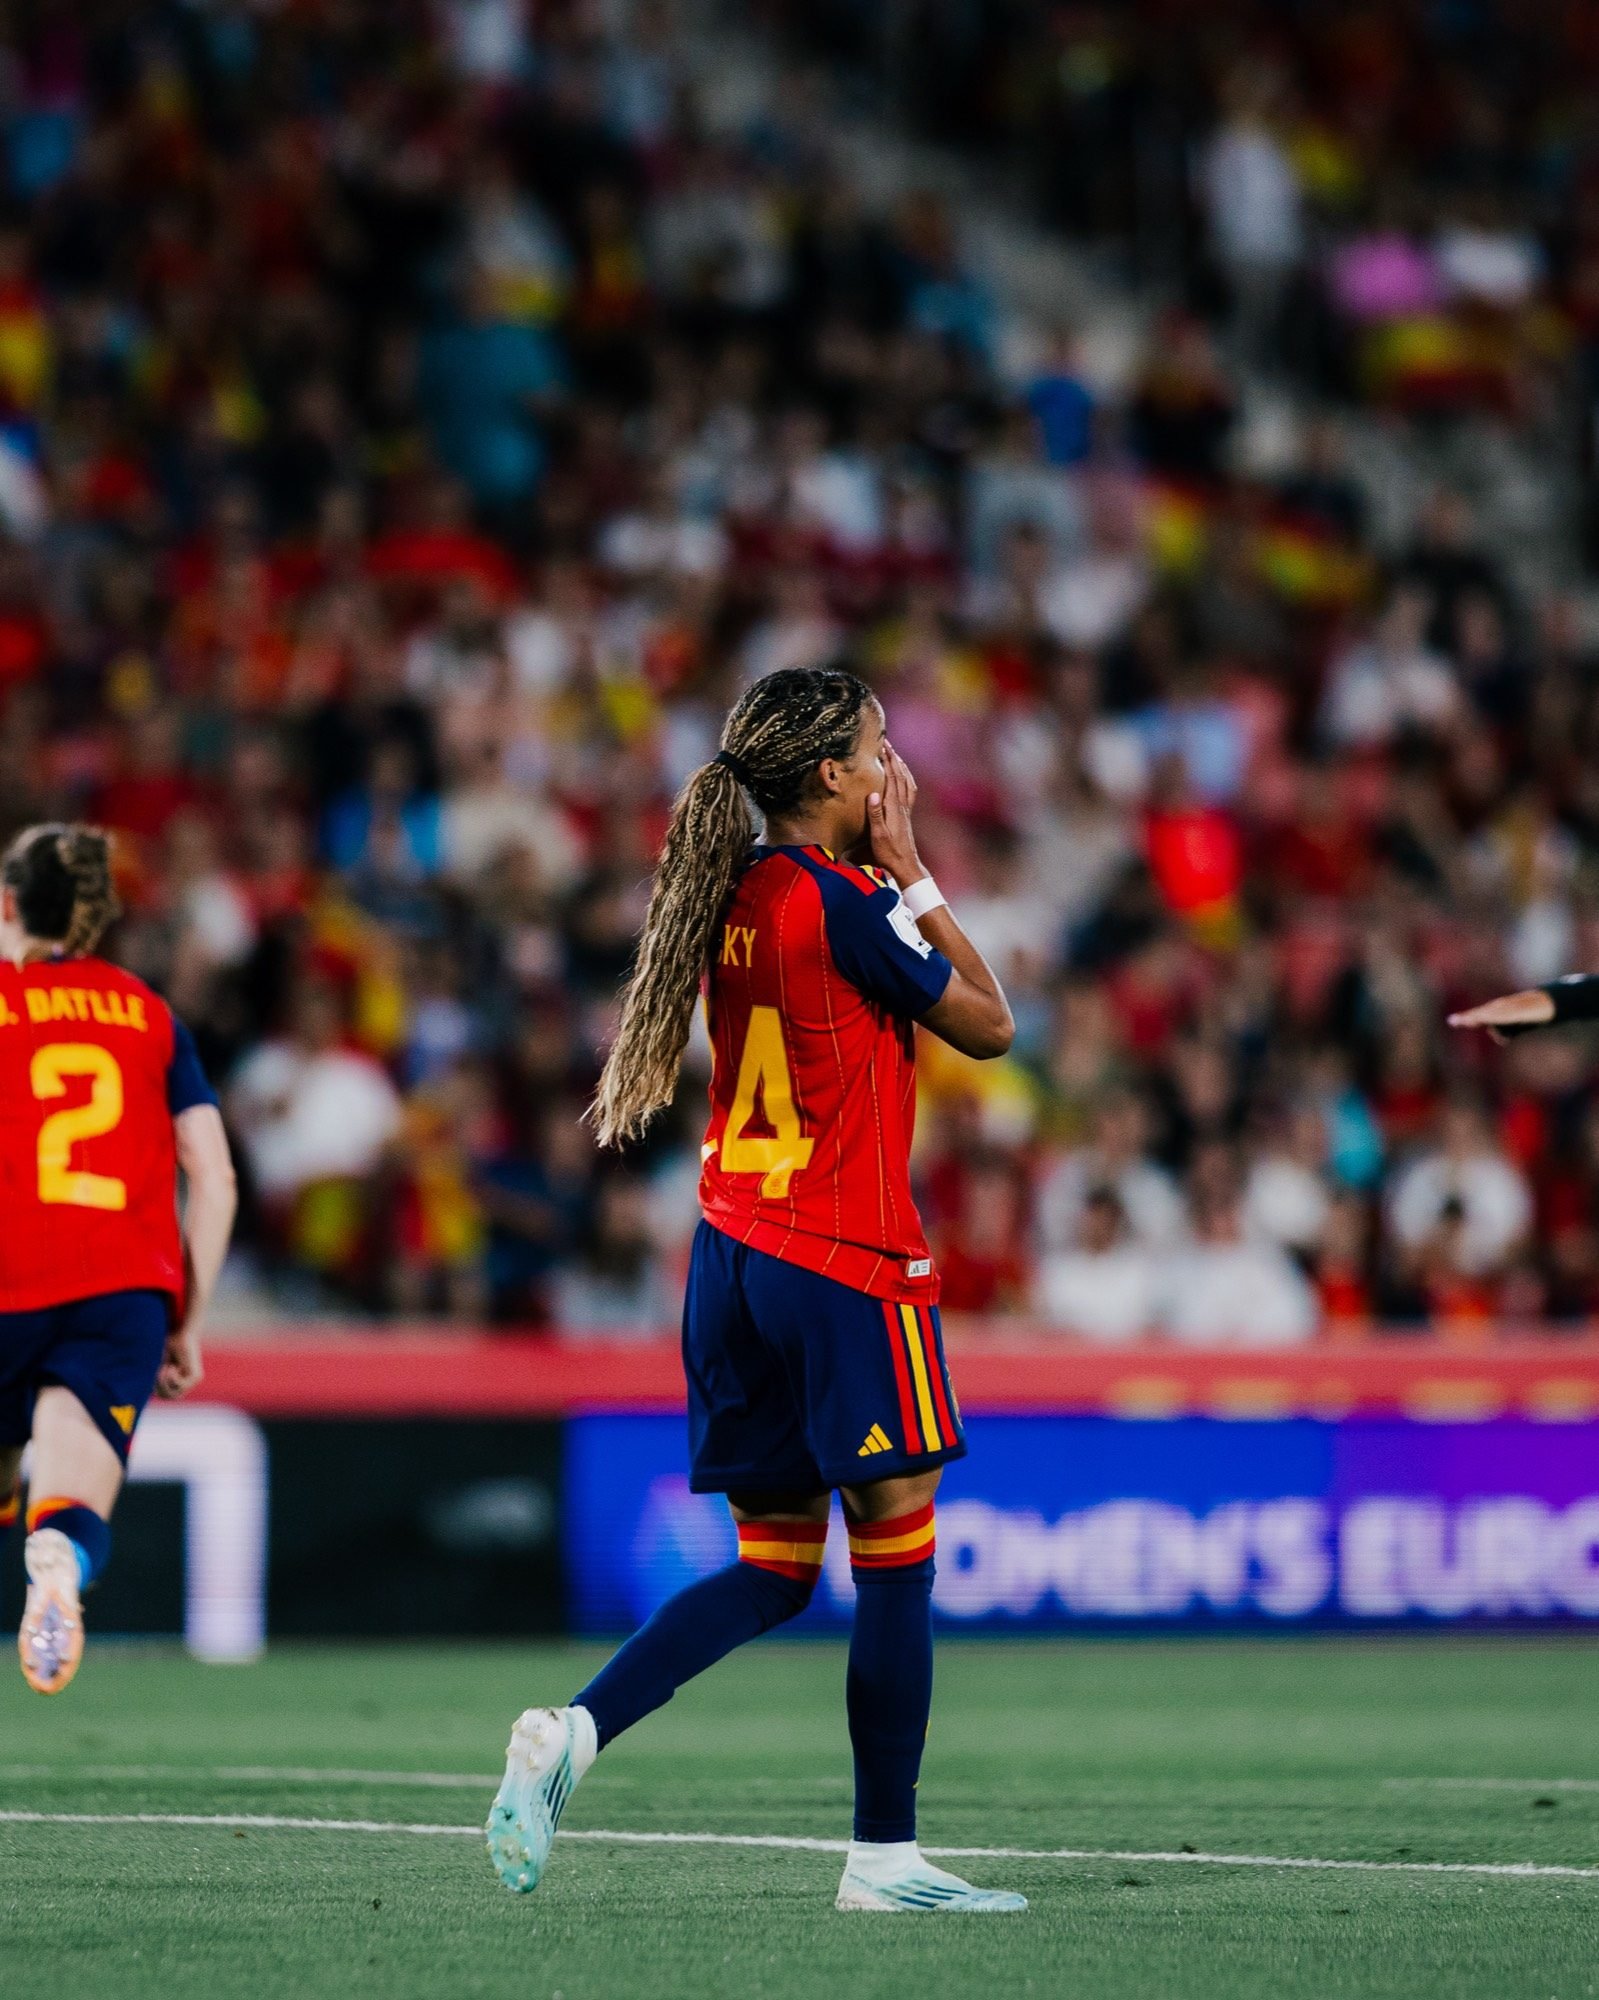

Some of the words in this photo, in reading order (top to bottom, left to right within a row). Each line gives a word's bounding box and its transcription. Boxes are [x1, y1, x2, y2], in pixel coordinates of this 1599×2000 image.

[718, 924, 757, 968] KY
[24, 986, 148, 1033] BATLLE
[30, 1042, 126, 1211] 2
[721, 1005, 815, 1199] 4
